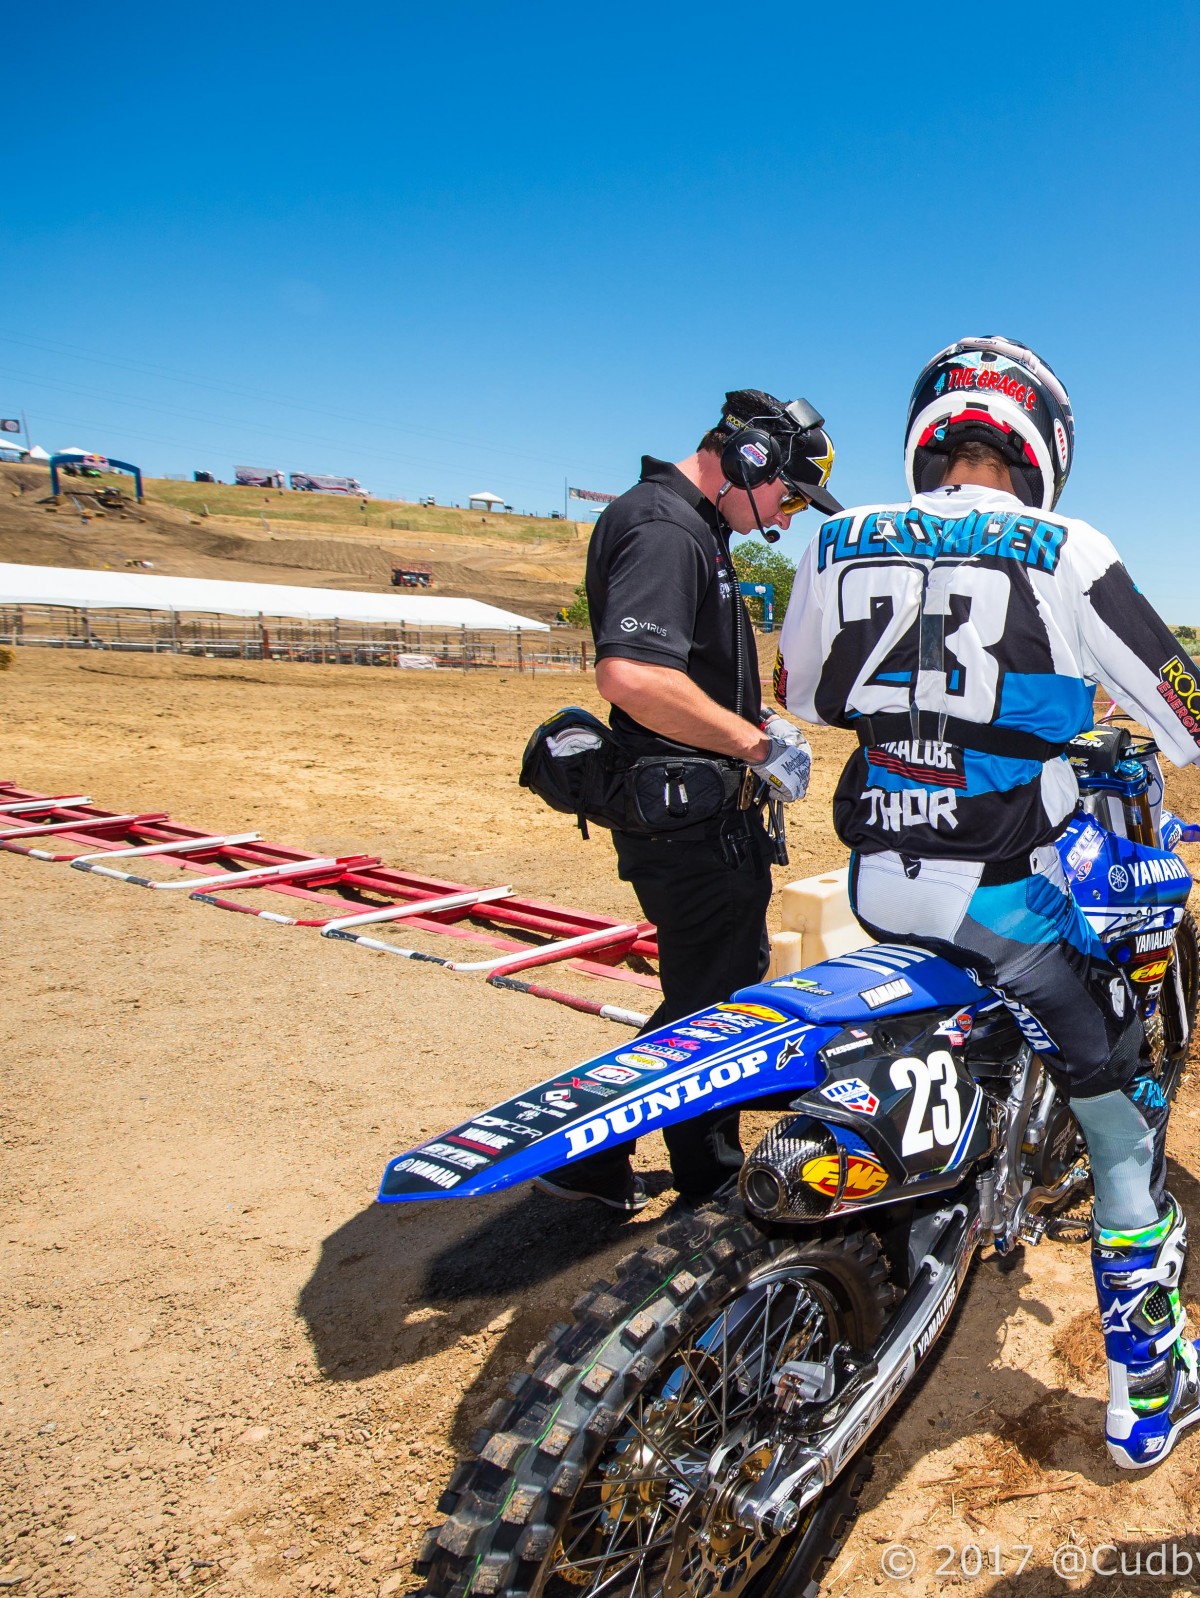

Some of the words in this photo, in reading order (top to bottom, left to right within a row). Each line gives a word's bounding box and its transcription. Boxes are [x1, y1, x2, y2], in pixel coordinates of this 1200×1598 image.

[949, 367, 977, 388] THE
[1056, 427, 1068, 463] BELL
[639, 622, 667, 637] VIRUS
[841, 565, 1011, 725] 23
[859, 787, 959, 832] THOR
[859, 978, 913, 1009] YAMAHA
[565, 1049, 769, 1159] DUNLOP
[826, 1079, 863, 1098] MX
[889, 1050, 963, 1159] 23
[458, 1127, 516, 1150] YAMALUBE
[420, 1143, 491, 1168] GYTR
[406, 1159, 462, 1189] YAMAHA
[801, 1159, 889, 1192] FMF
[917, 1280, 957, 1358] YAMALUBE
